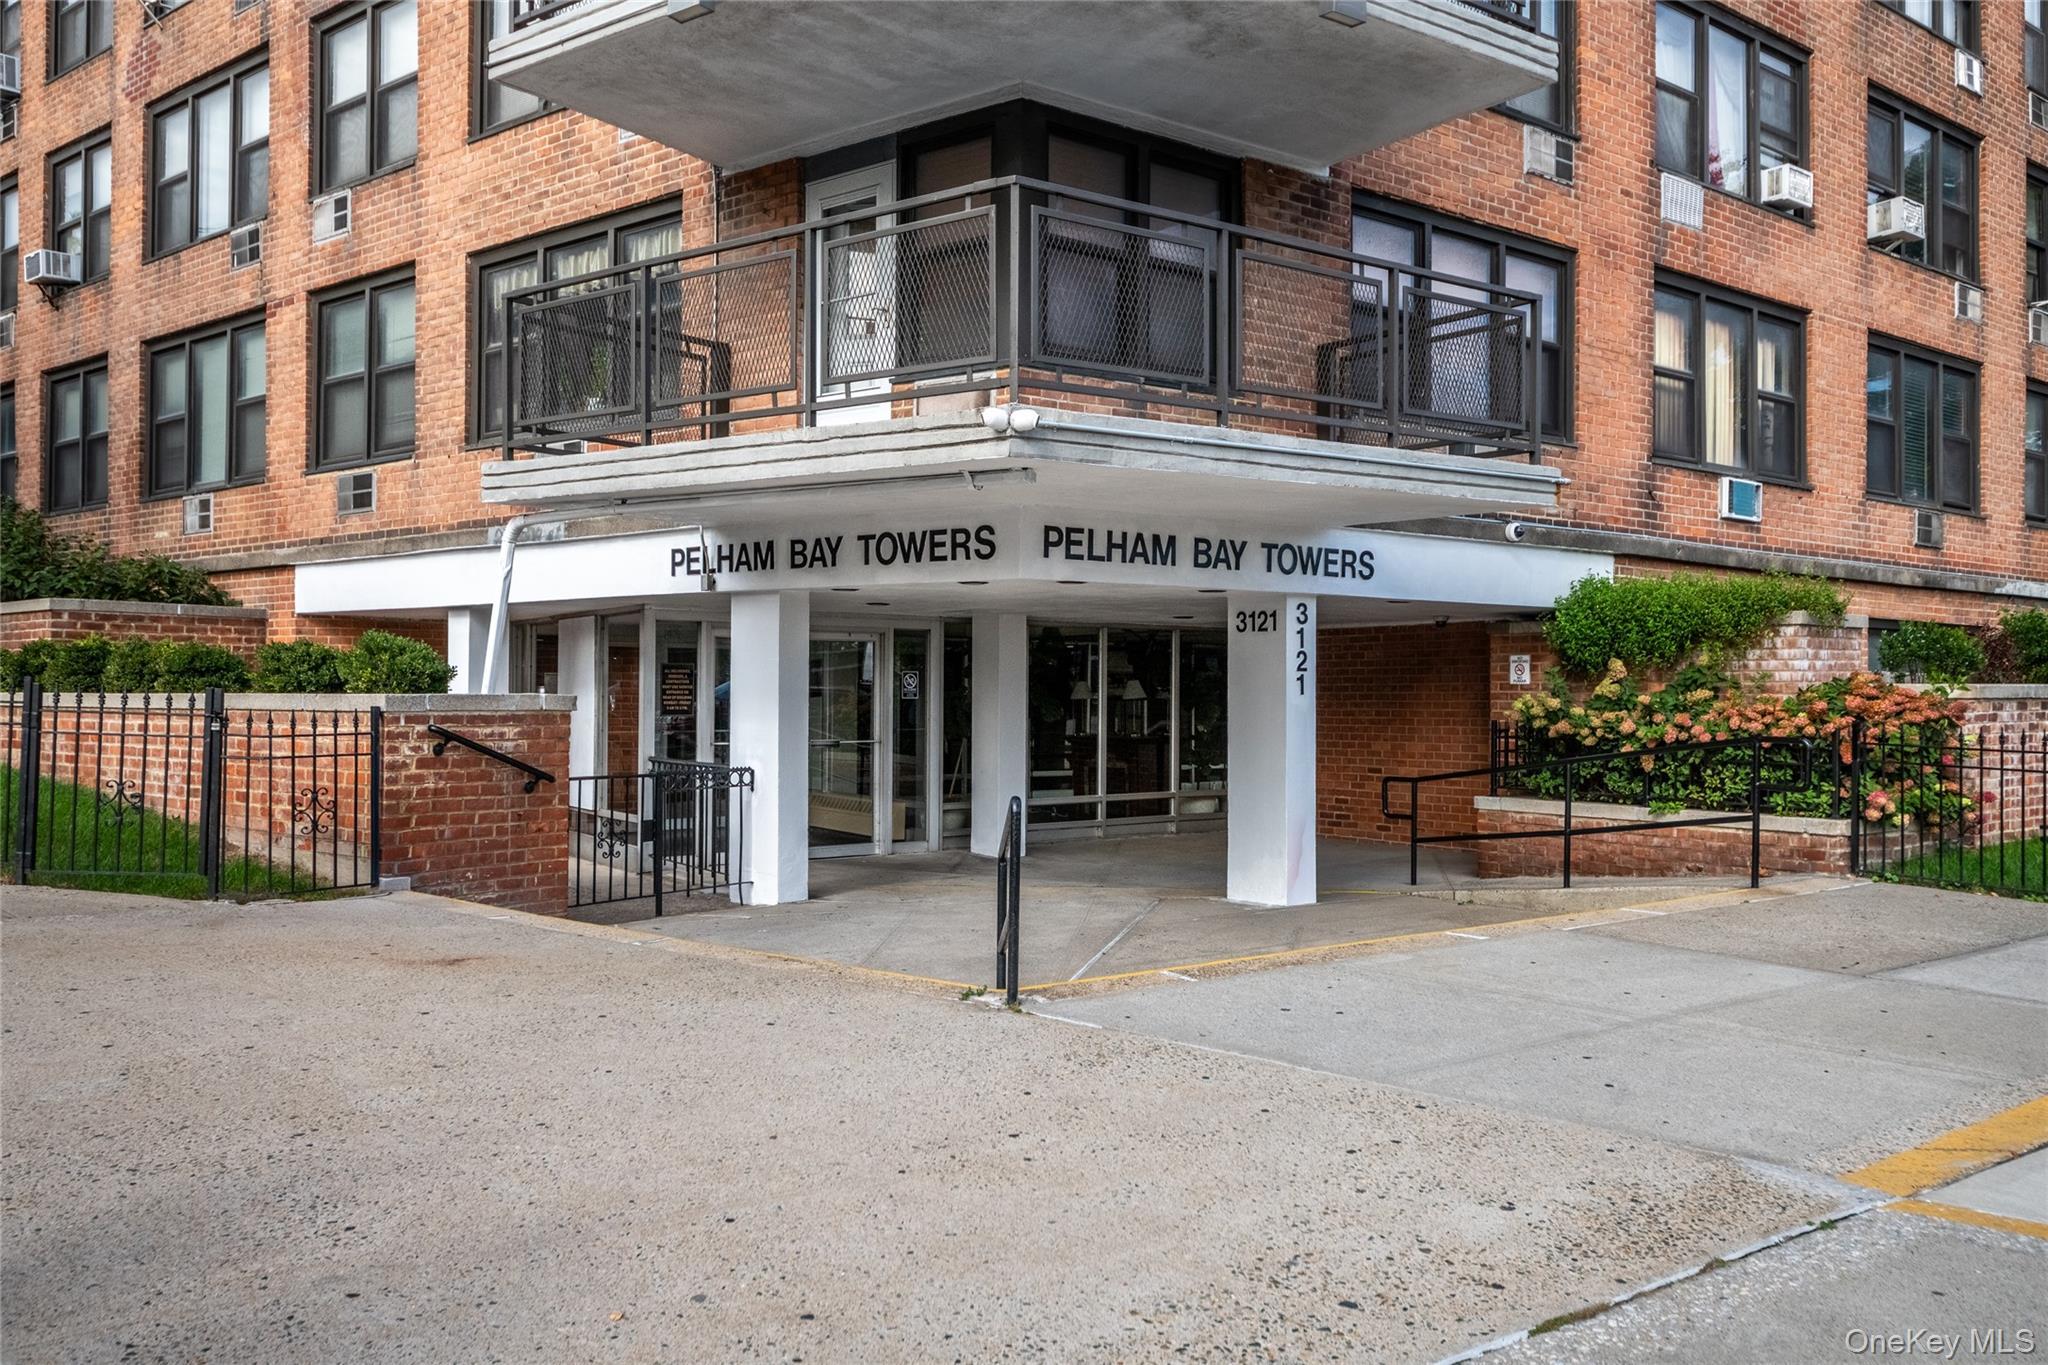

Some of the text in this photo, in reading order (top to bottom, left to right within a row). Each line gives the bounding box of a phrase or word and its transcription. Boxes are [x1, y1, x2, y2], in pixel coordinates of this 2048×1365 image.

[671, 524, 997, 577] PELHAM BAY TOWERS
[1043, 525, 1375, 581] PELHAM BAY TOWERS
[1236, 609, 1277, 633] 3121
[1296, 602, 1309, 696] 3121
